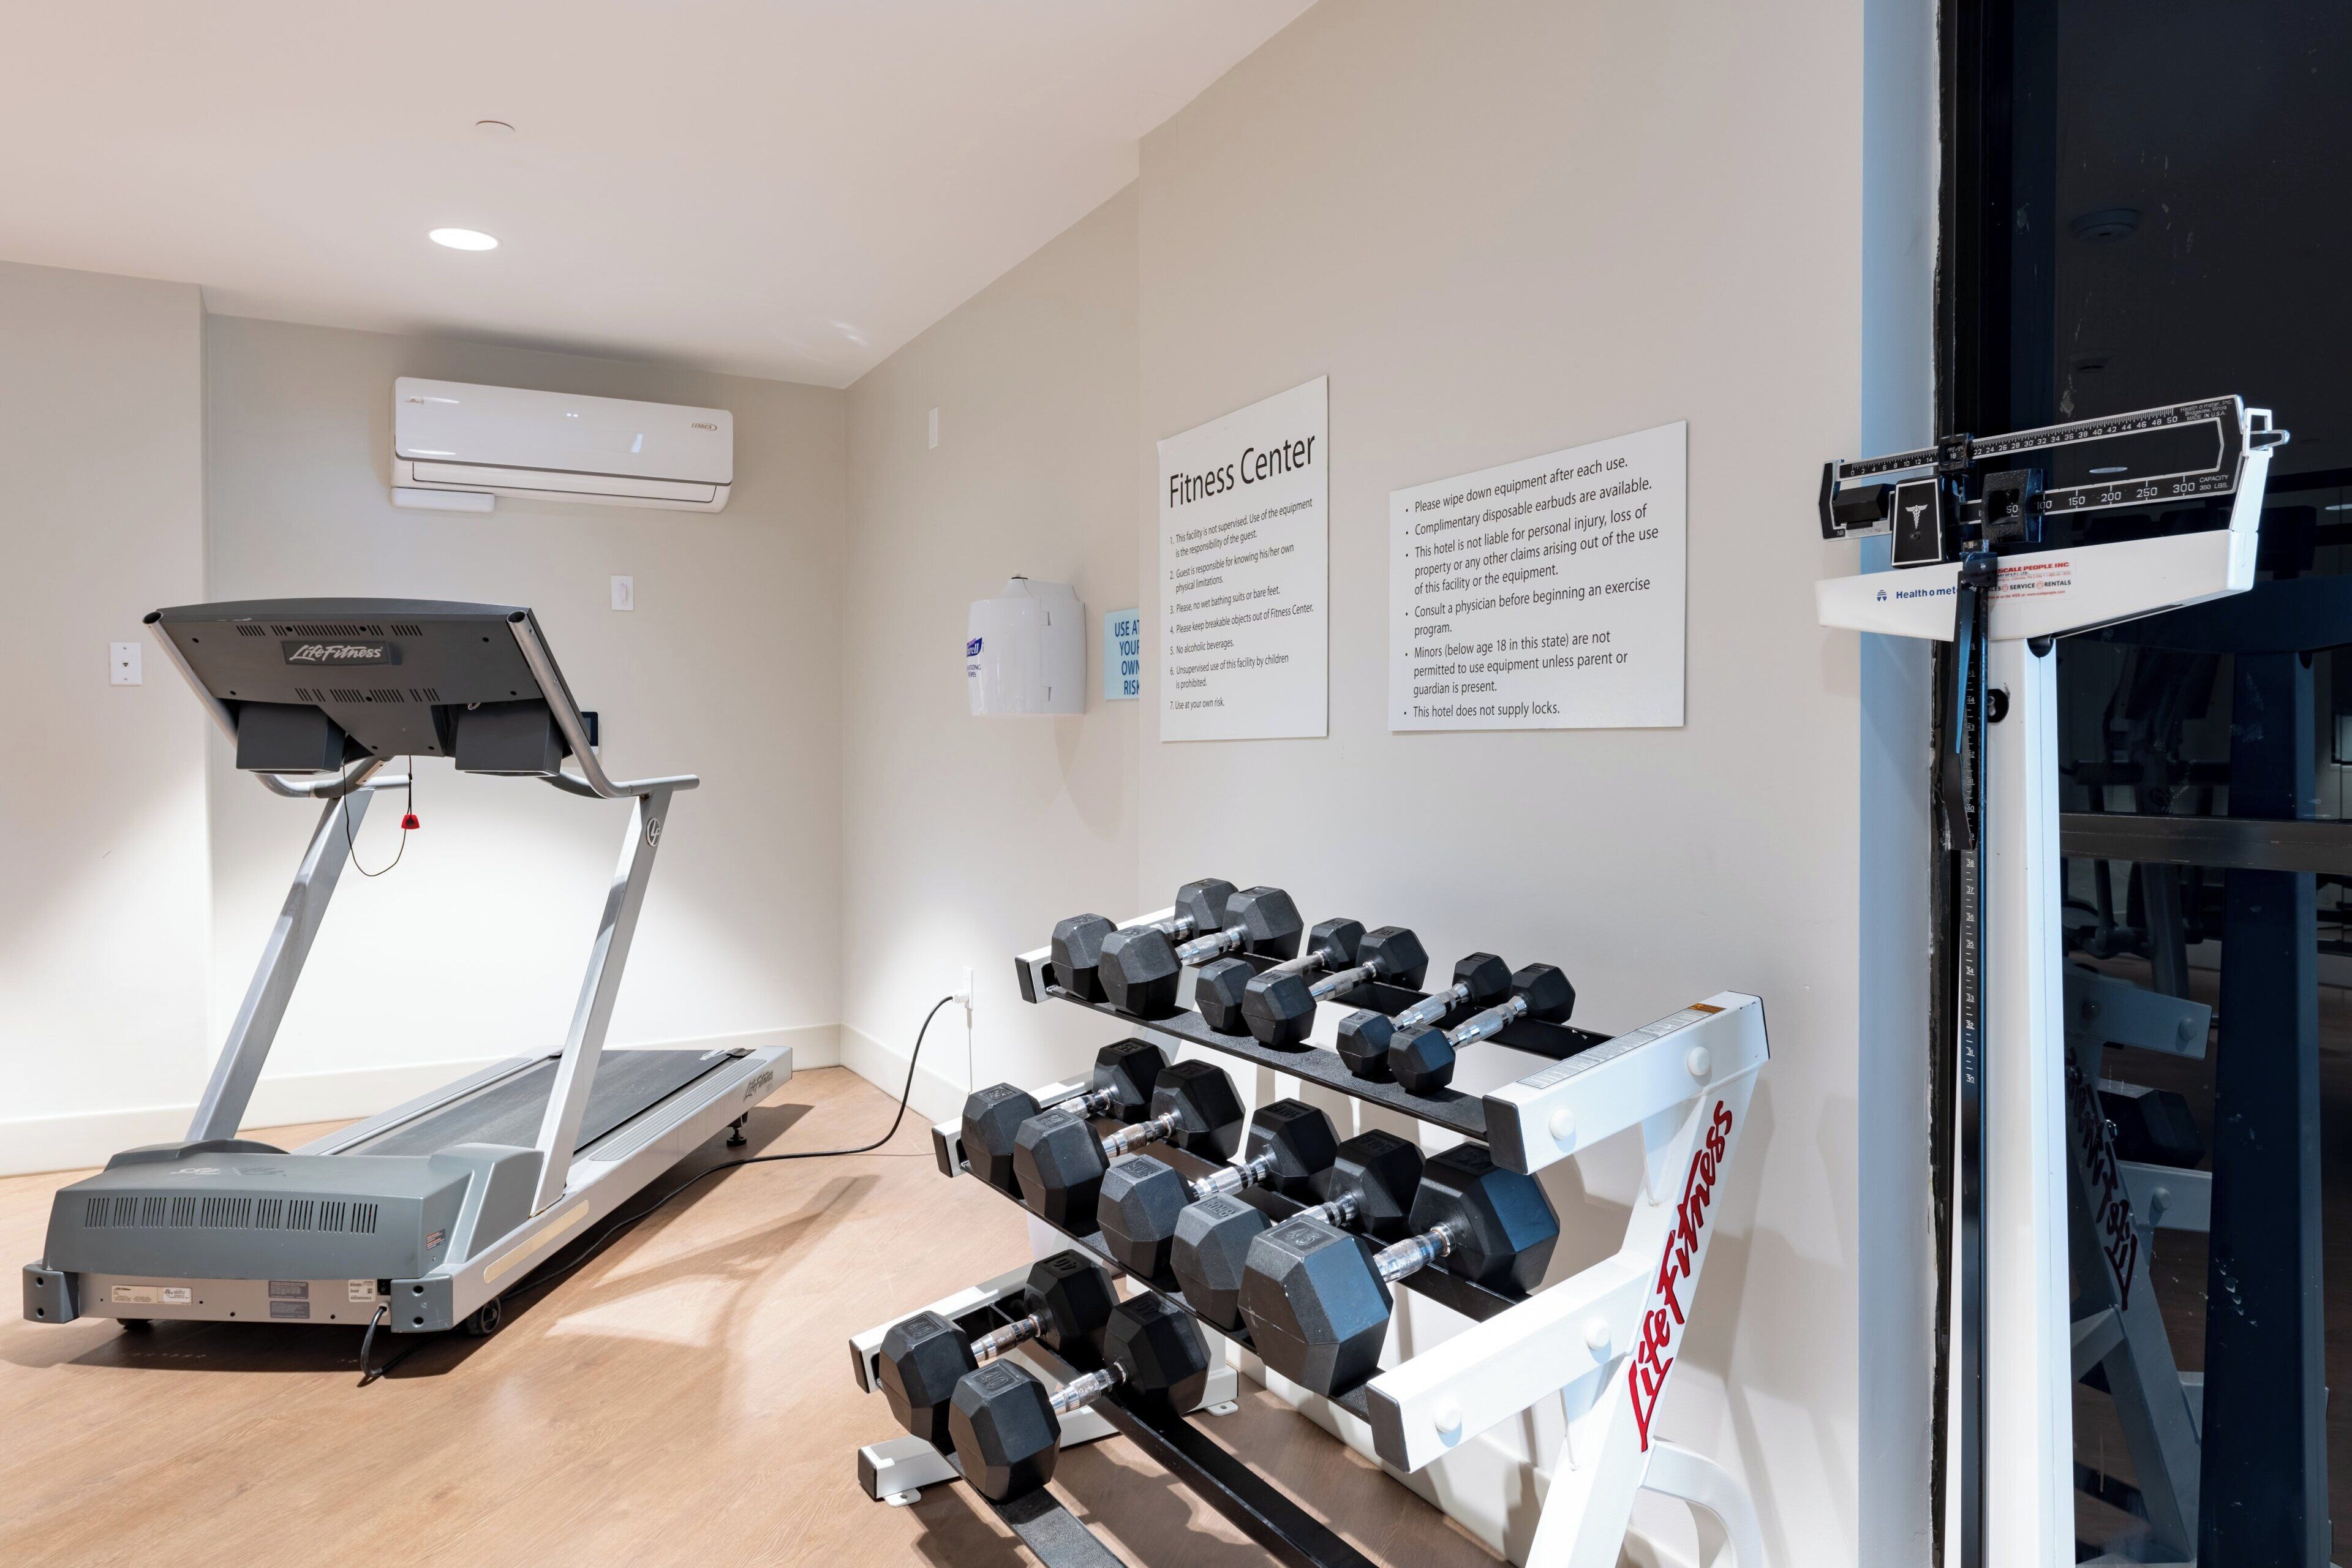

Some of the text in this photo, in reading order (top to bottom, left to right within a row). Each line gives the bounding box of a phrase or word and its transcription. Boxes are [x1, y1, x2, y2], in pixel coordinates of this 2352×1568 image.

[1170, 435, 1314, 508] Fitness Center
[1415, 458, 1627, 513] Please wipe down equipment after each use.
[2006, 483, 2195, 513] 50 100 150 200 250 300
[1415, 477, 1651, 535] Complimentary disposable earbuds are available.
[1170, 536, 1174, 545] 1.
[1175, 533, 1186, 543] This
[1186, 529, 1202, 540] facility
[1208, 524, 1217, 534] not
[1218, 514, 1248, 532] supervised.
[1250, 513, 1260, 523] Use
[1261, 508, 1267, 520] of
[1268, 507, 1278, 518] the
[1279, 498, 1312, 516] equipment
[1415, 503, 1647, 557] This hotel is not liable for personal injury, loss of
[1180, 547, 1188, 556] the
[1189, 538, 1223, 554] responsibility
[1223, 535, 1229, 545] of
[1229, 533, 1239, 544] the
[1240, 529, 1257, 544] guest.
[1170, 605, 1174, 614] 3.
[1176, 603, 1192, 612] Please,
[1200, 599, 1210, 608] wet
[1211, 595, 1231, 606] bathing
[1232, 592, 1245, 602] suits
[1253, 589, 1266, 598] bare
[1267, 586, 1280, 595] feet.
[1414, 578, 1650, 617] Consult a physician before beginning an exercise
[1936, 586, 1958, 597] met
[1115, 621, 1129, 637] USE
[1169, 604, 1313, 634] 4. Please keep breakable objects out of Fitness Center.
[1414, 624, 1452, 638] program.
[1170, 639, 1234, 655] 5. No alcoholic beverages.
[1414, 631, 1610, 658] Minors (below age 18 in this state) are not
[1170, 701, 1174, 709] 7.
[1175, 700, 1184, 709] Use
[1190, 701, 1202, 710] your
[1214, 696, 1224, 706] risk.
[1412, 701, 1559, 718] This hotel does not supply locks.
[1204, 1201, 1235, 1217] 30LB
[1286, 1227, 1322, 1245] 45
[908, 1321, 933, 1336] 40
[981, 1371, 1008, 1388] 40
